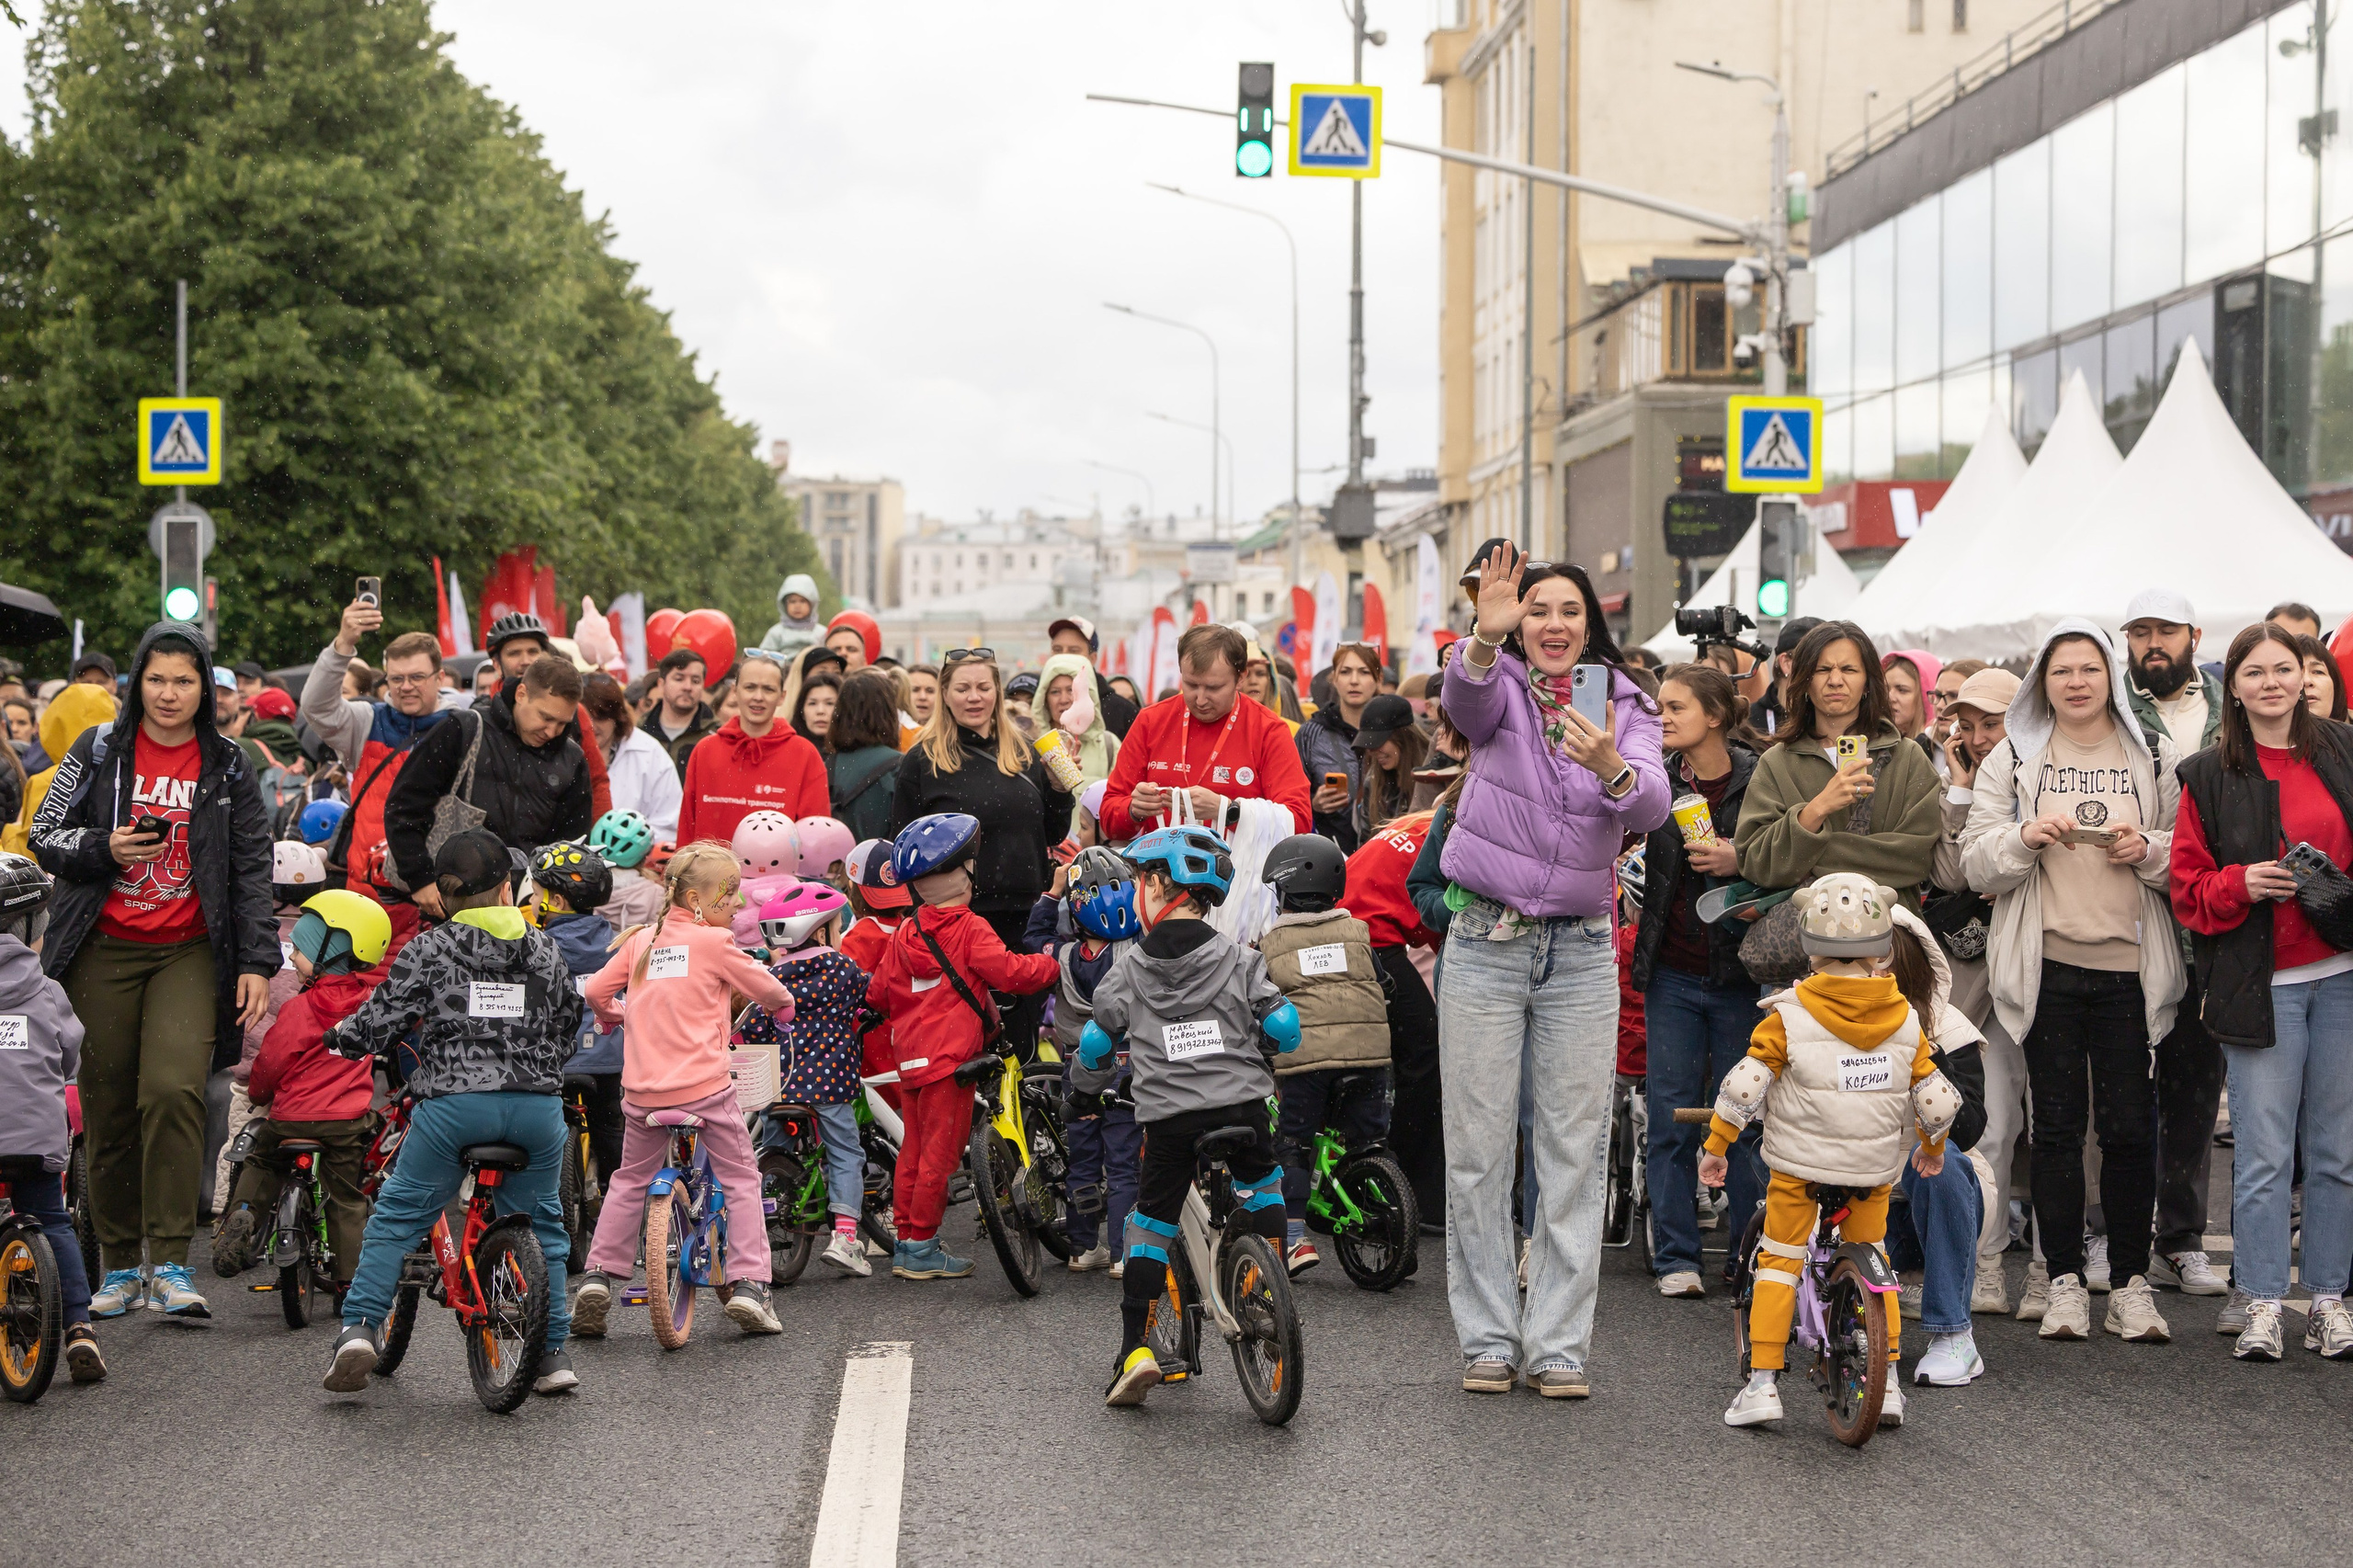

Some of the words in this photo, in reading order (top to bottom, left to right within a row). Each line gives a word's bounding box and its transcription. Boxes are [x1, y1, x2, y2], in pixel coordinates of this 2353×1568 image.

[702, 794, 746, 805] Беспилотный
[746, 799, 786, 810] транспорт
[1139, 837, 1164, 850] SCOTT
[795, 907, 819, 916] BRIKO
[1313, 960, 1329, 970] ЛЕВ
[479, 1003, 483, 1011] 8
[1169, 1023, 1196, 1034] МАКС
[1846, 1072, 1889, 1090] КСЕНИЯ
